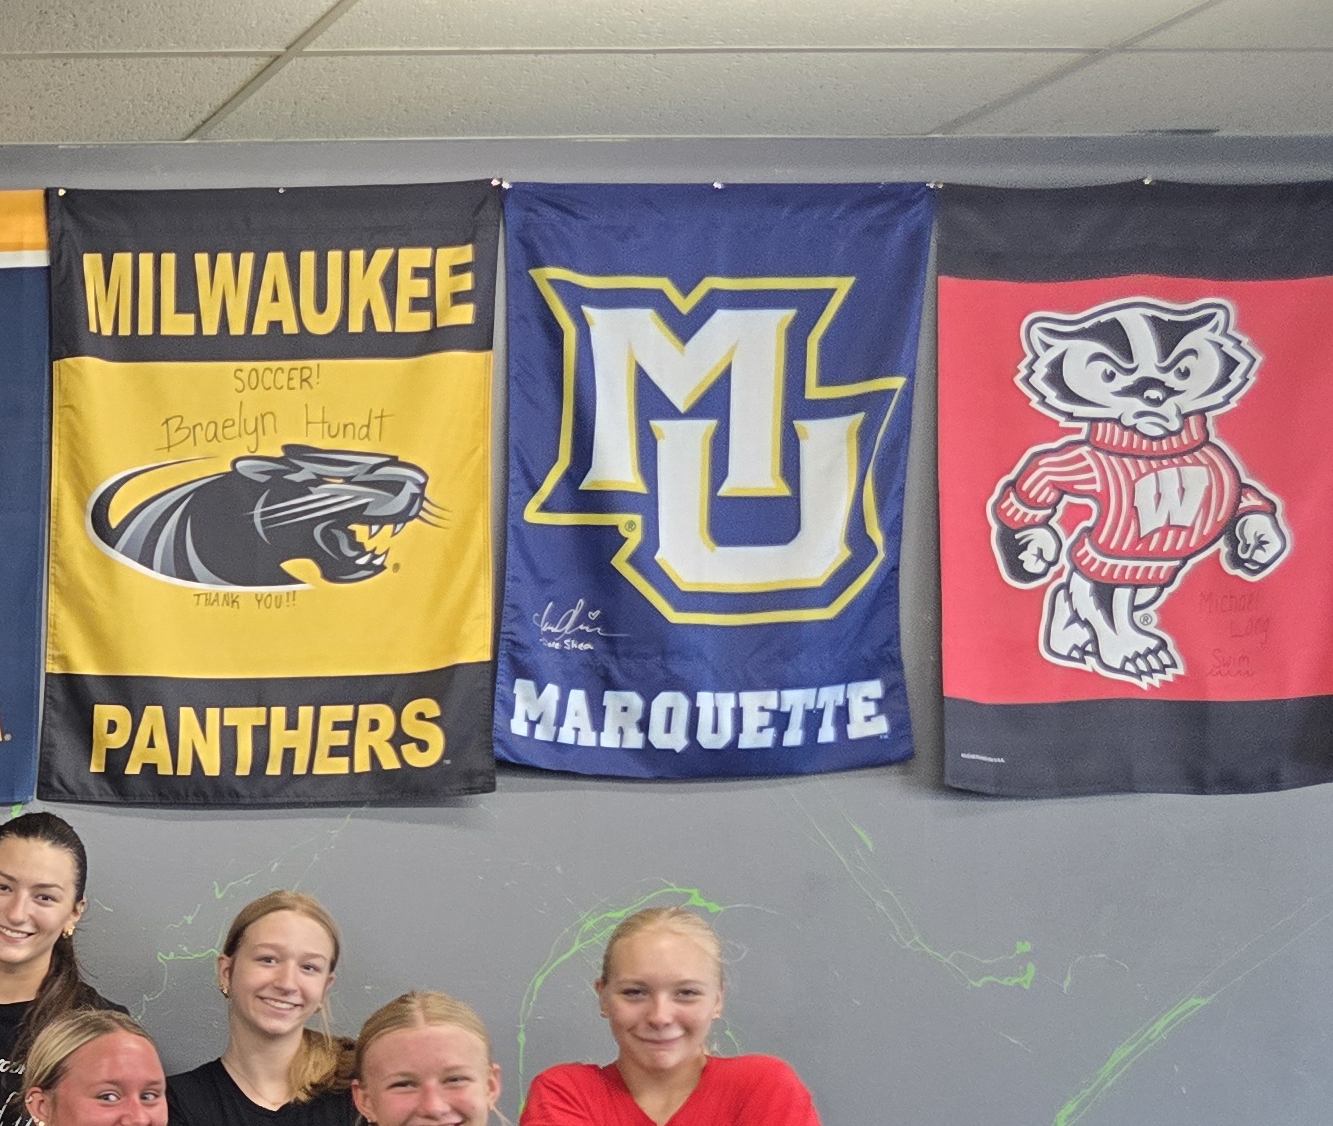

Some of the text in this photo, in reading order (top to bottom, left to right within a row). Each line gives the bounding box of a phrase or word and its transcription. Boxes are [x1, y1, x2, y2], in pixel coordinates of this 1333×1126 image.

[82, 244, 475, 336] MILWAUKEE
[233, 362, 322, 394] SOCCER!
[155, 401, 395, 454] Braelyn Hundt
[578, 305, 866, 593] MU
[1133, 464, 1210, 540] W
[192, 590, 298, 610] THANK YOU!!
[89, 698, 447, 777] PANTHERS
[510, 678, 890, 754] MARQUETTE
